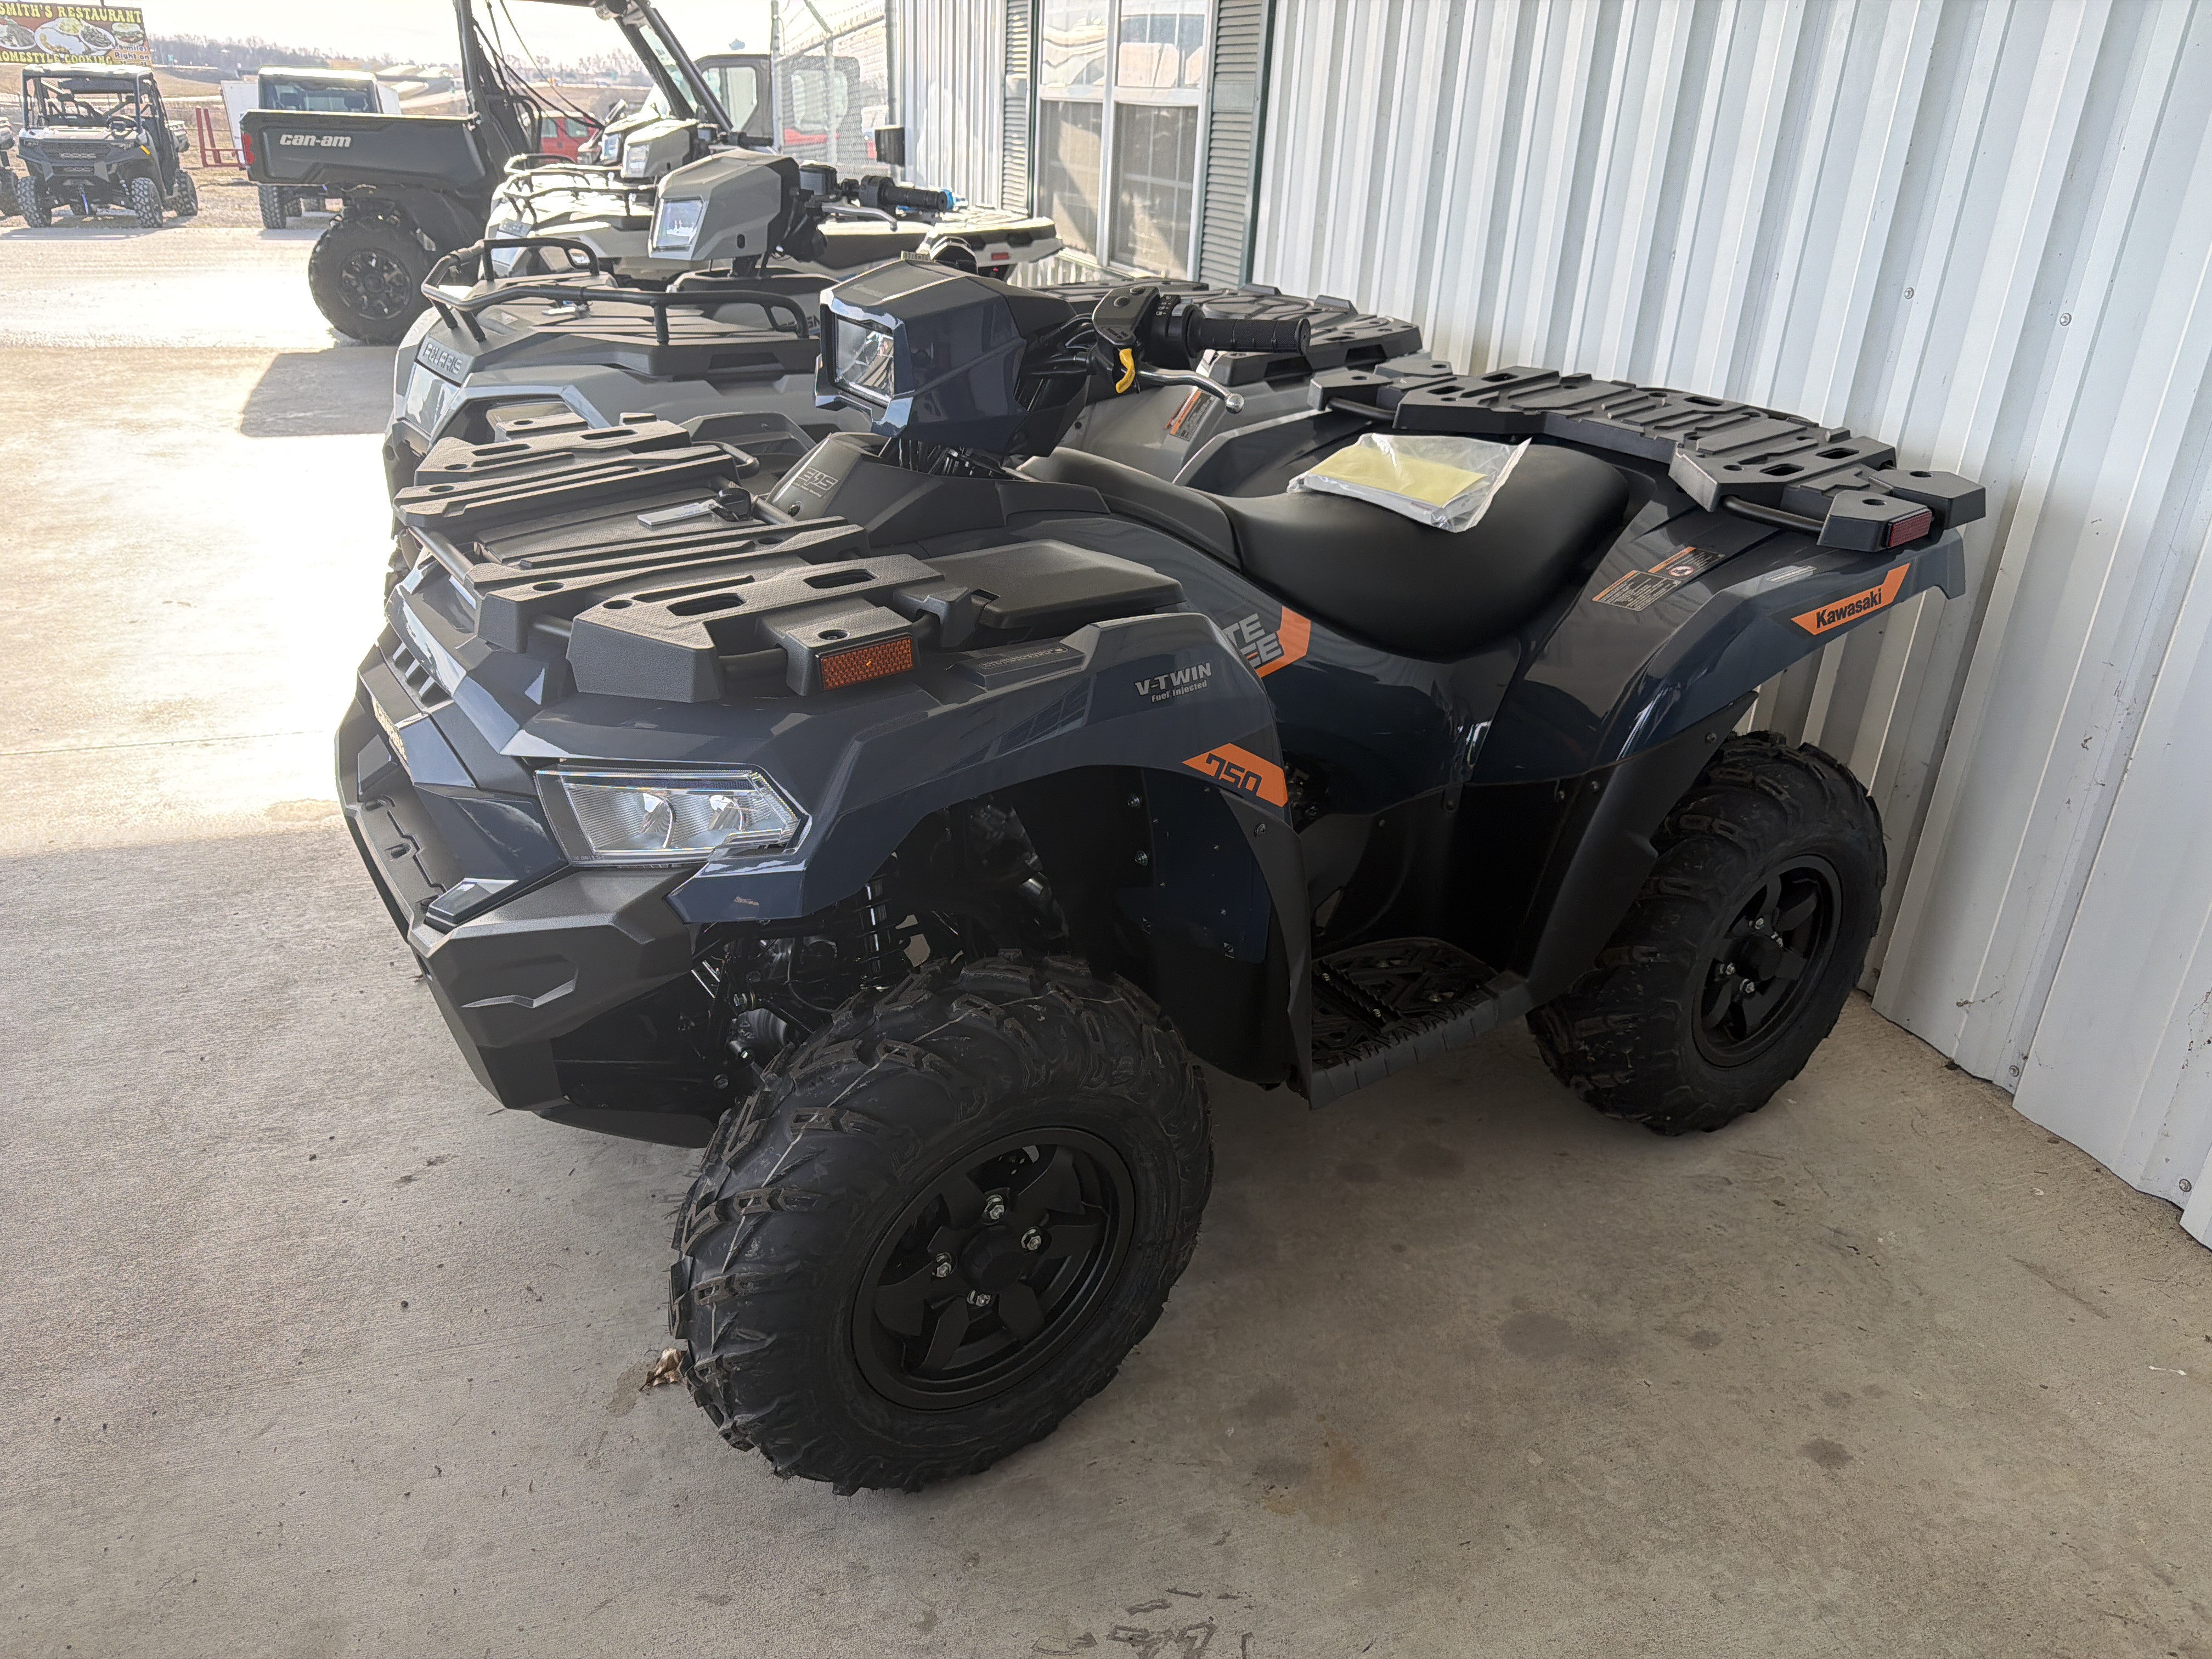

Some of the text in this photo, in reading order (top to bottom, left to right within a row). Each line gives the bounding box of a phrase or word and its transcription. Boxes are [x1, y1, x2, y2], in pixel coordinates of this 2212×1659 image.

[0, 2, 142, 23] SMITH'S RESTAURANT
[0, 50, 60, 63] OMESTYLE
[64, 54, 113, 64] COOKING
[280, 134, 351, 147] can-am
[422, 342, 462, 375] POLARIS
[1816, 588, 1882, 629] Kawasaki
[1135, 662, 1211, 696] V-TWIN
[1151, 680, 1207, 703] Fuel Injected
[1206, 753, 1262, 795] 750
